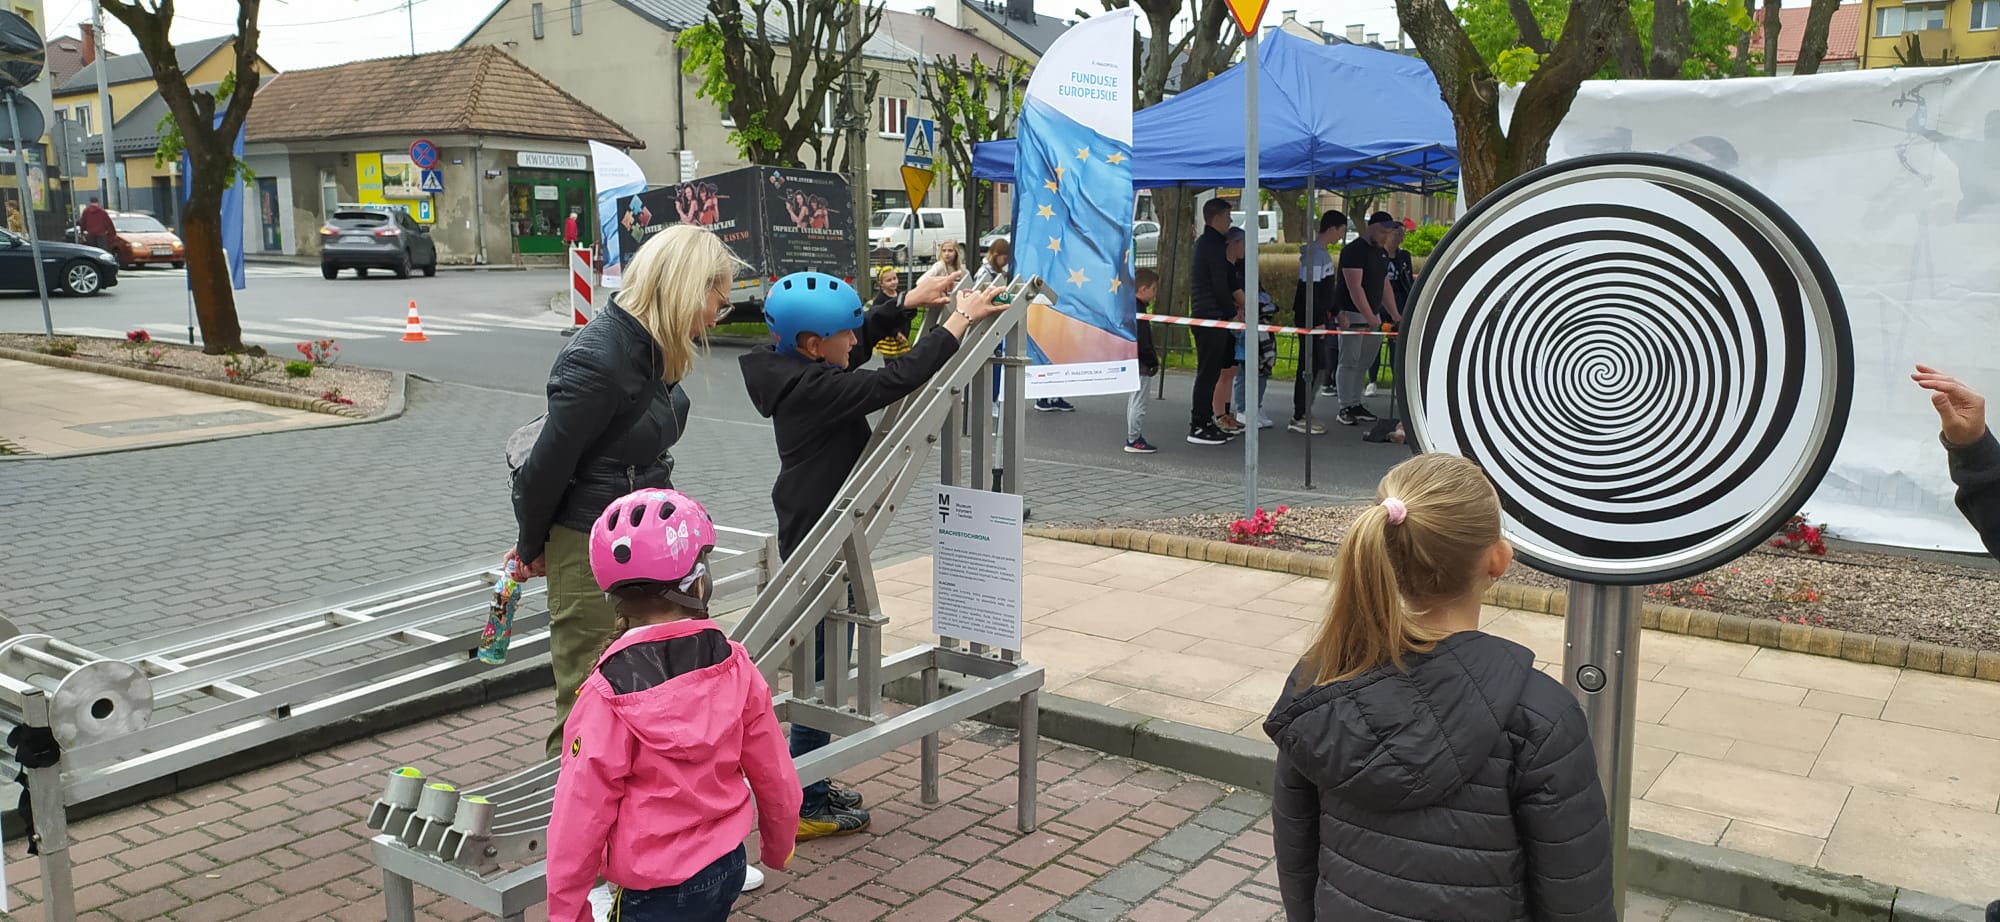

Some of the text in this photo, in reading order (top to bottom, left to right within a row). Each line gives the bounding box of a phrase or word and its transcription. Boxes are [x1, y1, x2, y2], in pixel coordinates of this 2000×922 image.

[525, 154, 579, 167] KWIACIARNIA
[421, 202, 429, 218] P
[938, 528, 991, 542] BRACHISTOCHRONA
